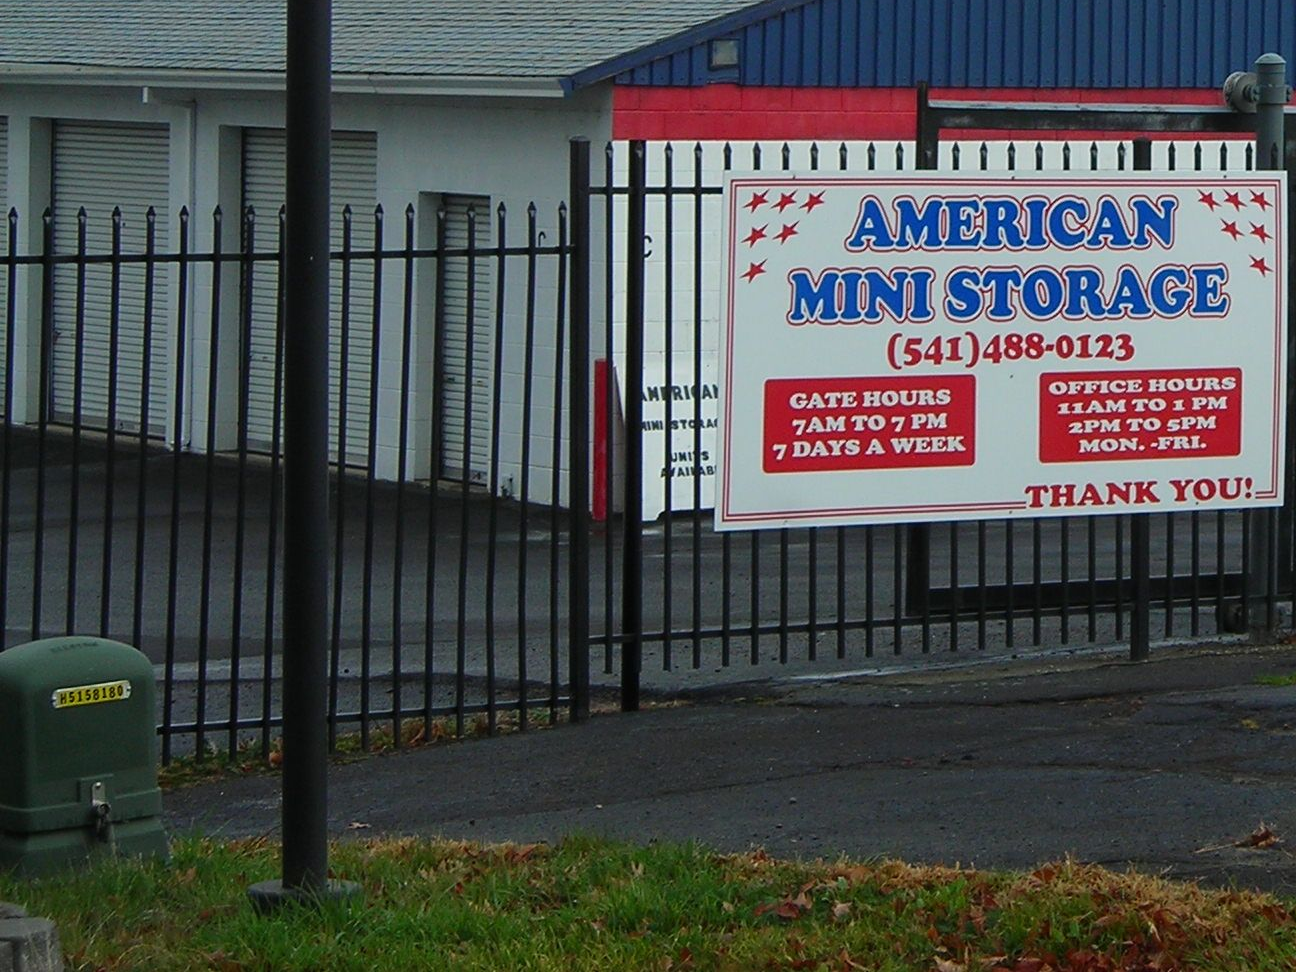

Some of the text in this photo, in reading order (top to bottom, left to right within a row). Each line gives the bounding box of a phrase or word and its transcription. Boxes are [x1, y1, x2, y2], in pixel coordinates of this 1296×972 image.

[845, 194, 1178, 251] AMERICAN
[787, 263, 1230, 325] MINI STORAGE
[887, 332, 1135, 369] (541)488-0123
[1048, 377, 1237, 395] OFFICE HOURS
[789, 389, 951, 409] GATE HOURS
[1057, 399, 1126, 415] 11AM
[1131, 398, 1167, 412] TO
[1191, 396, 1228, 411] PM
[792, 413, 948, 435] 7AM TO 7 PM
[1068, 415, 1217, 434] 2PM TO 5PM
[772, 436, 966, 460] 7 DAYS A WEEK
[1078, 437, 1145, 453] MON.
[671, 451, 710, 463] UNIS
[1024, 477, 1253, 508] THANK YOU!
[60, 685, 124, 705] H5158180
